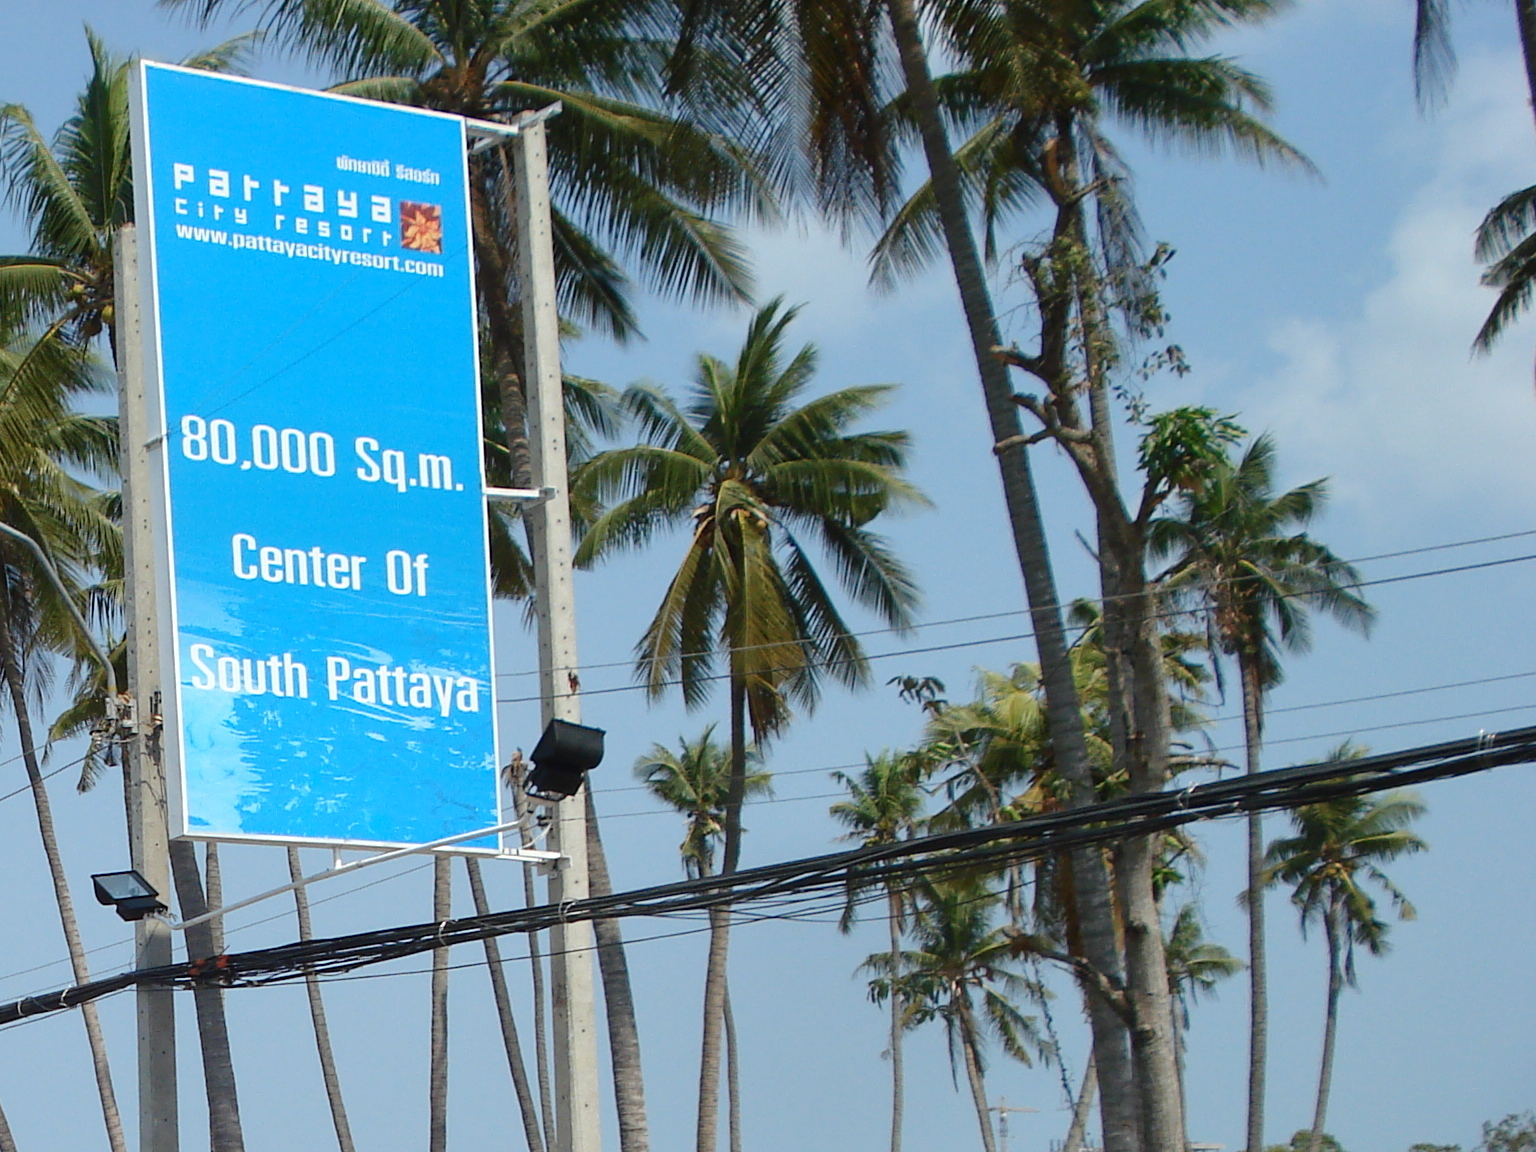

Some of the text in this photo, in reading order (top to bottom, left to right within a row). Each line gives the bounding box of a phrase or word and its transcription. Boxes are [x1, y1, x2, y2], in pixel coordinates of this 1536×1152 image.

[175, 223, 445, 278] www.pattayacityresort.com
[180, 414, 464, 493] 80,000 Sq.m.
[231, 533, 430, 597] Center Of
[189, 643, 480, 718] South Pattaya
